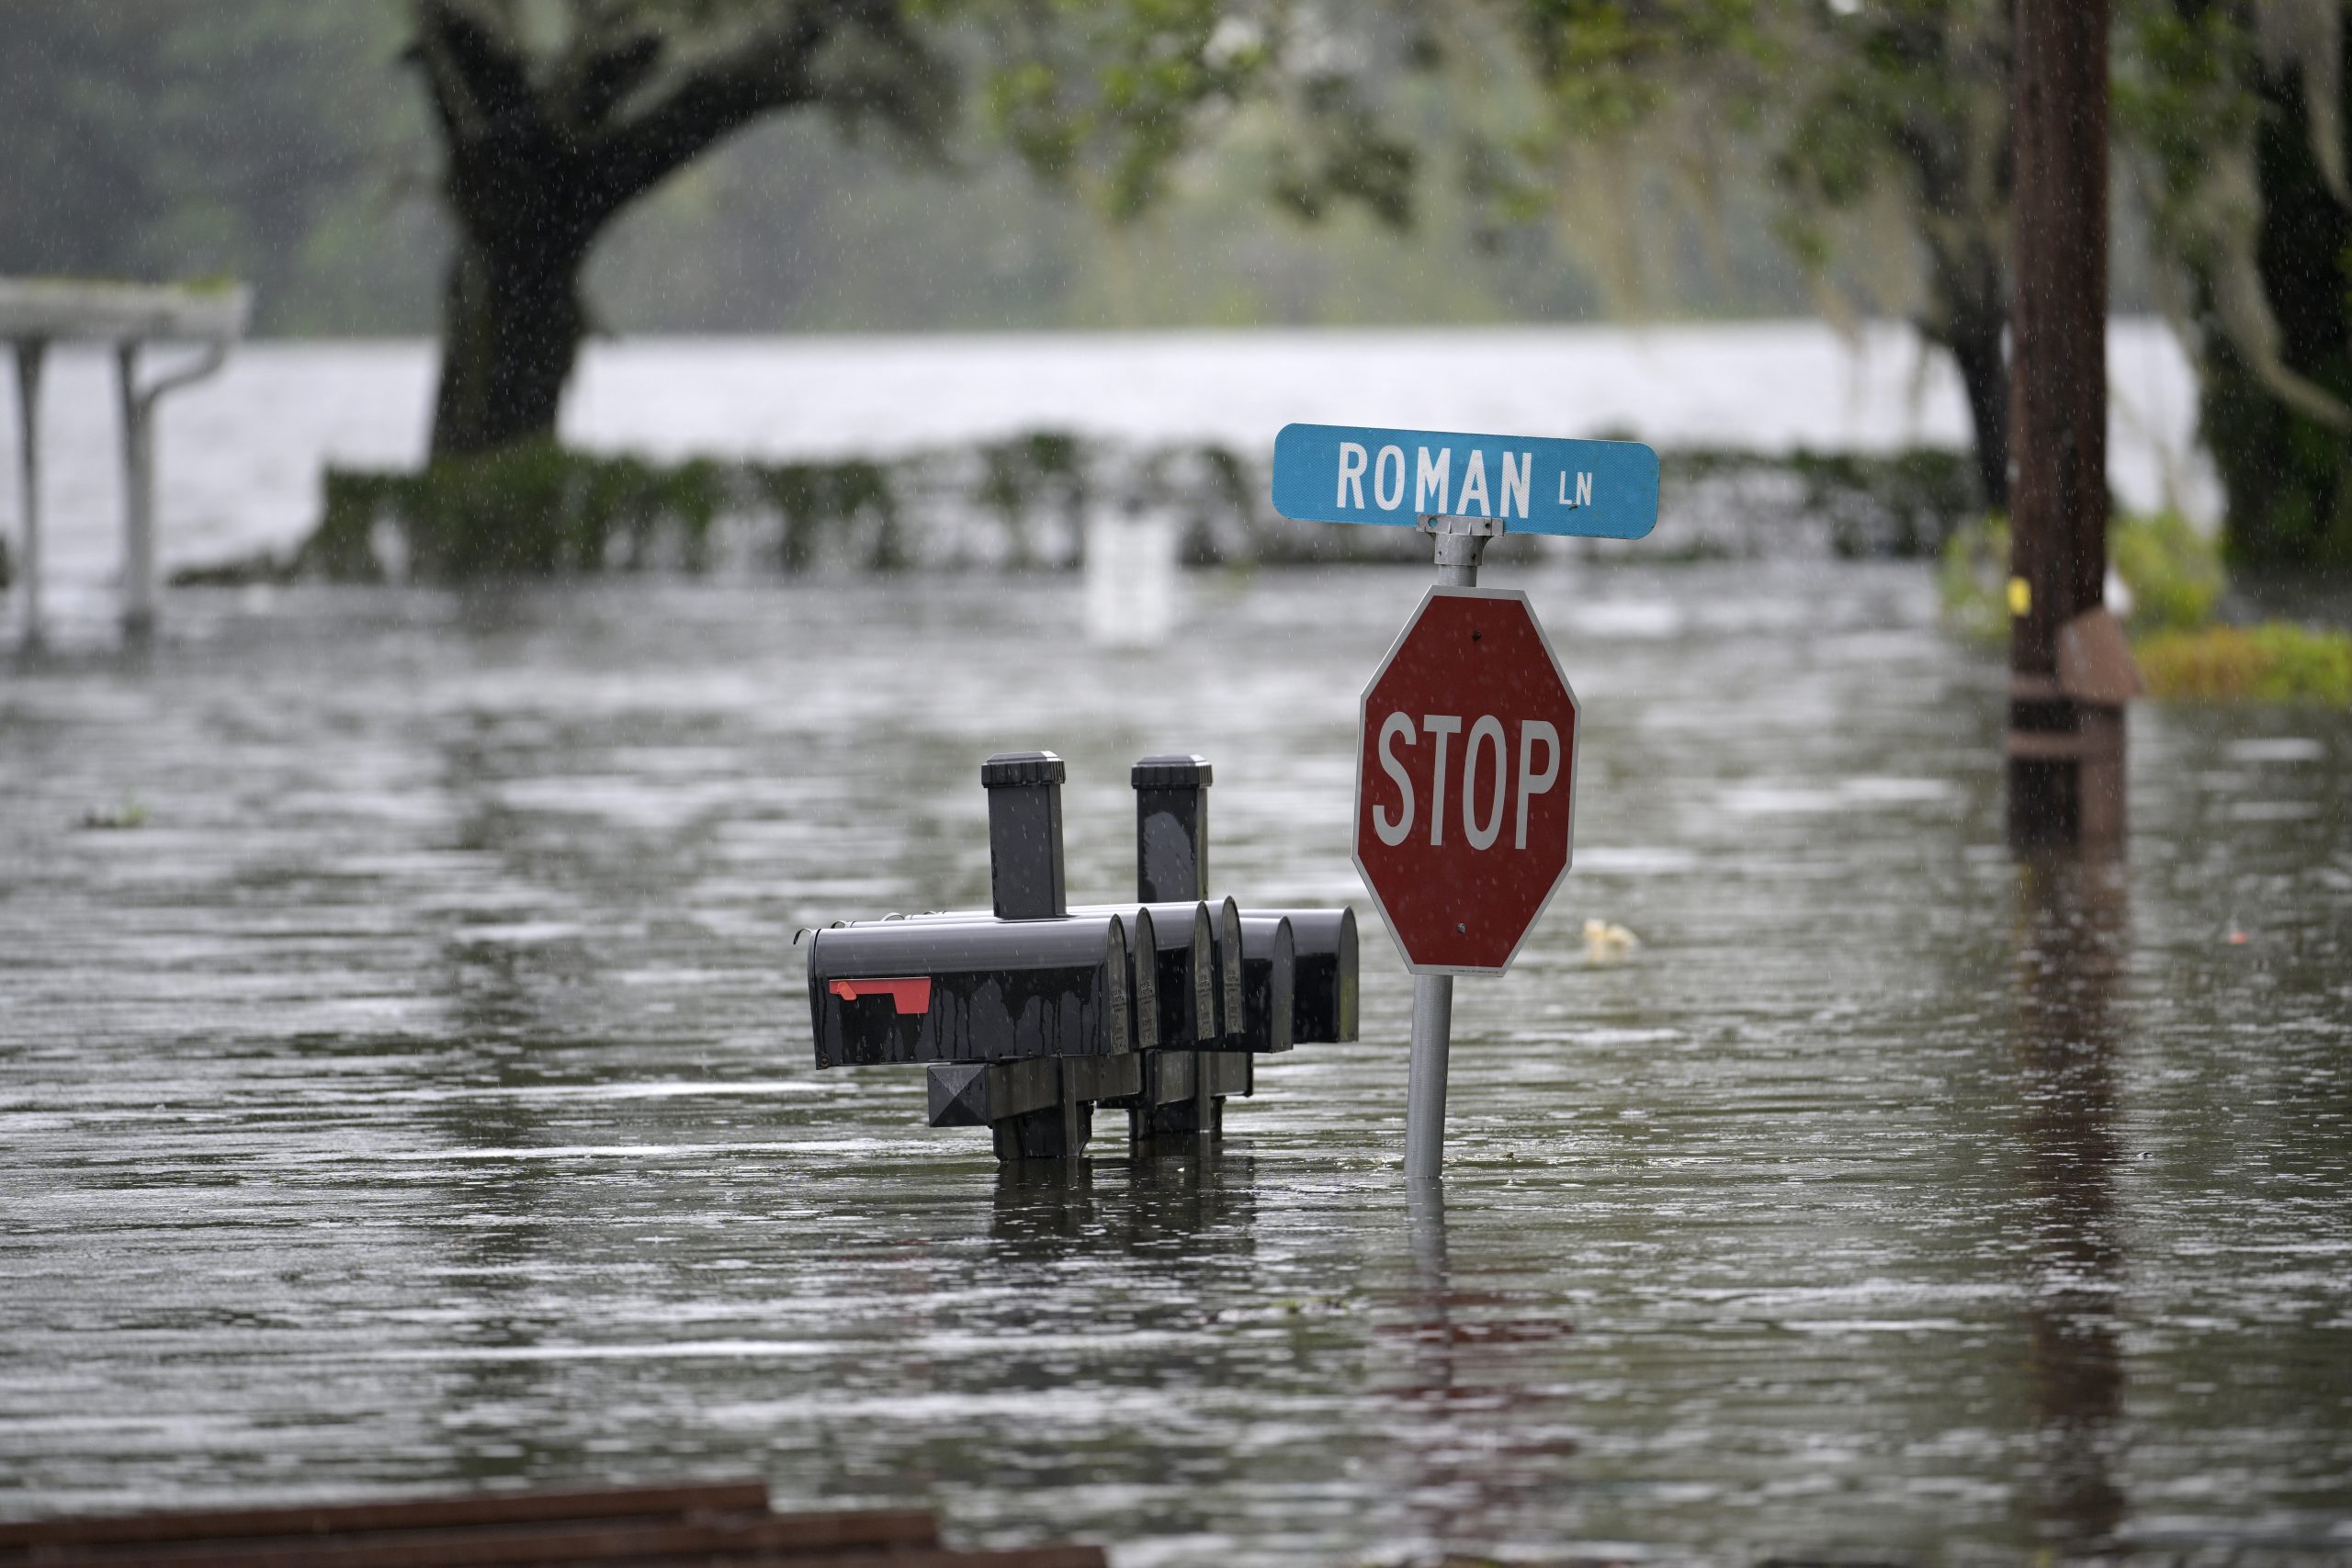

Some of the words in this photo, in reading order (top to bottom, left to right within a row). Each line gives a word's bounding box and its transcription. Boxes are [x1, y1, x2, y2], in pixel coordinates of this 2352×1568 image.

[1337, 442, 1532, 518] ROMAN
[1559, 470, 1592, 506] LN
[1373, 711, 1560, 851] STOP
